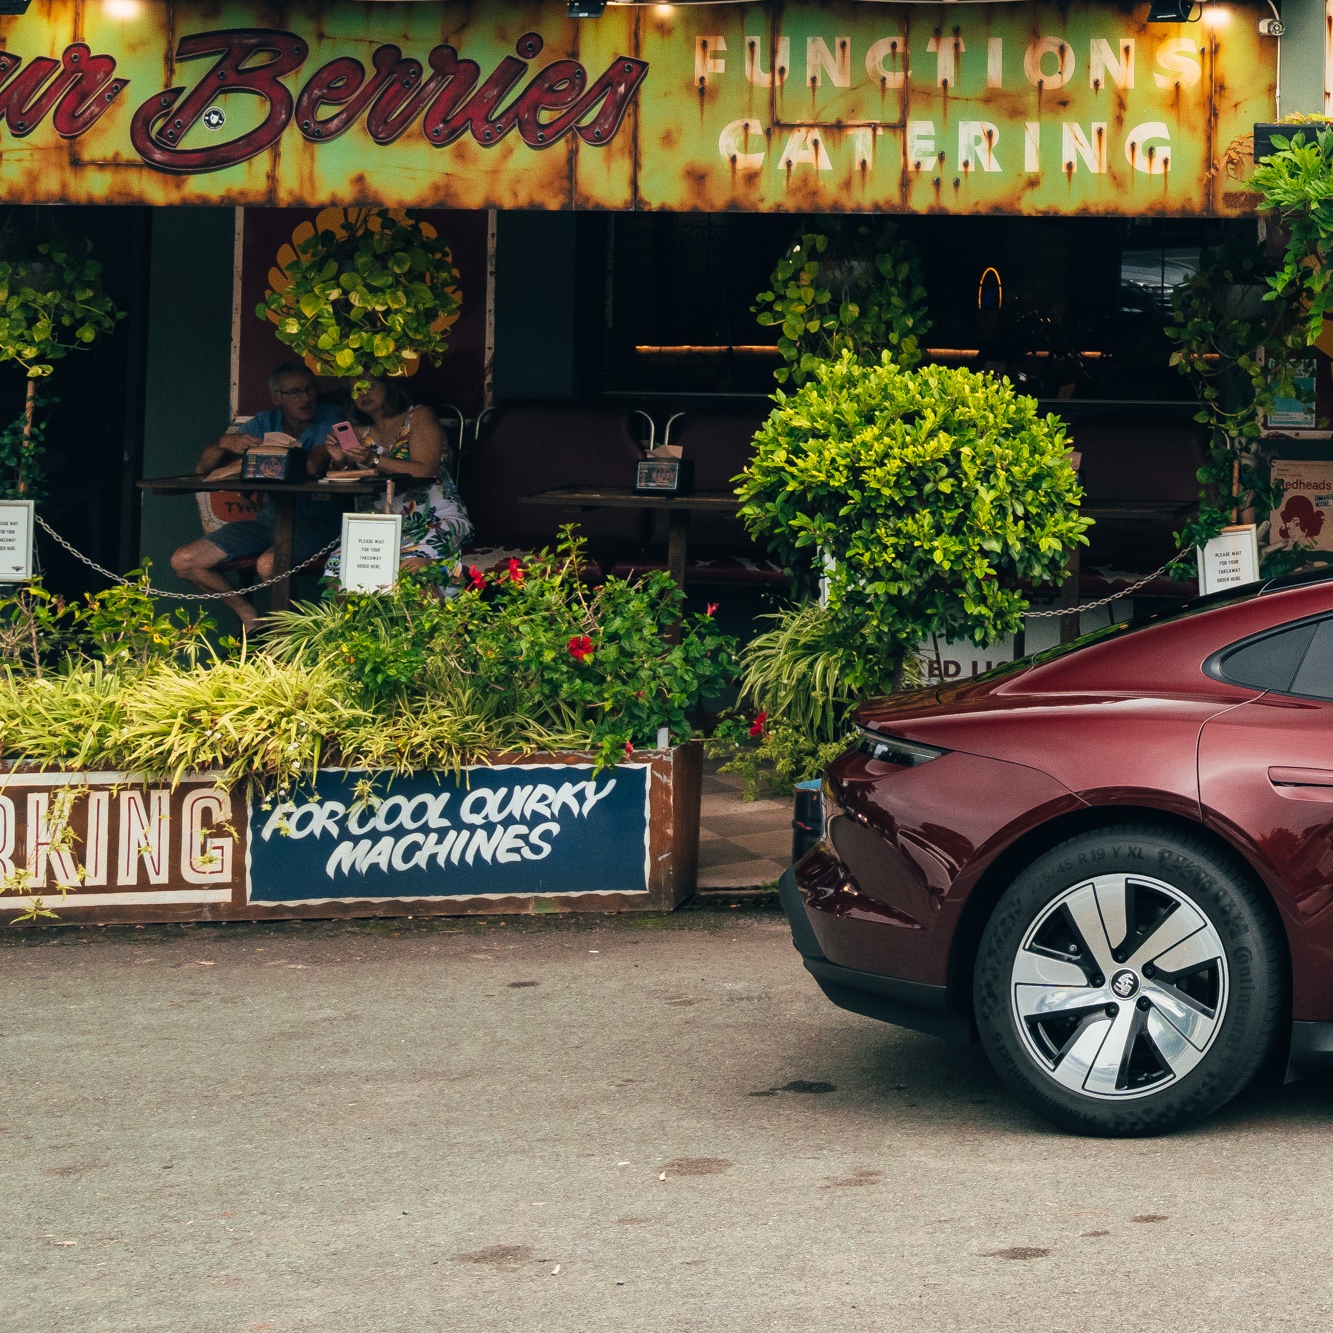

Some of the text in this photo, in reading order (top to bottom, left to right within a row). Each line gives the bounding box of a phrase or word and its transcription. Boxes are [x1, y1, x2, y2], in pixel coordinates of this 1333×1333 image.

[693, 35, 1203, 90] FUNCTIONS
[130, 28, 650, 175] Berries
[719, 119, 1172, 175] CATERING
[1282, 479, 1332, 490] edheads
[0, 788, 233, 888] KING
[262, 779, 617, 841] FOR COOL QUIRKY
[326, 822, 561, 880] MACHINES
